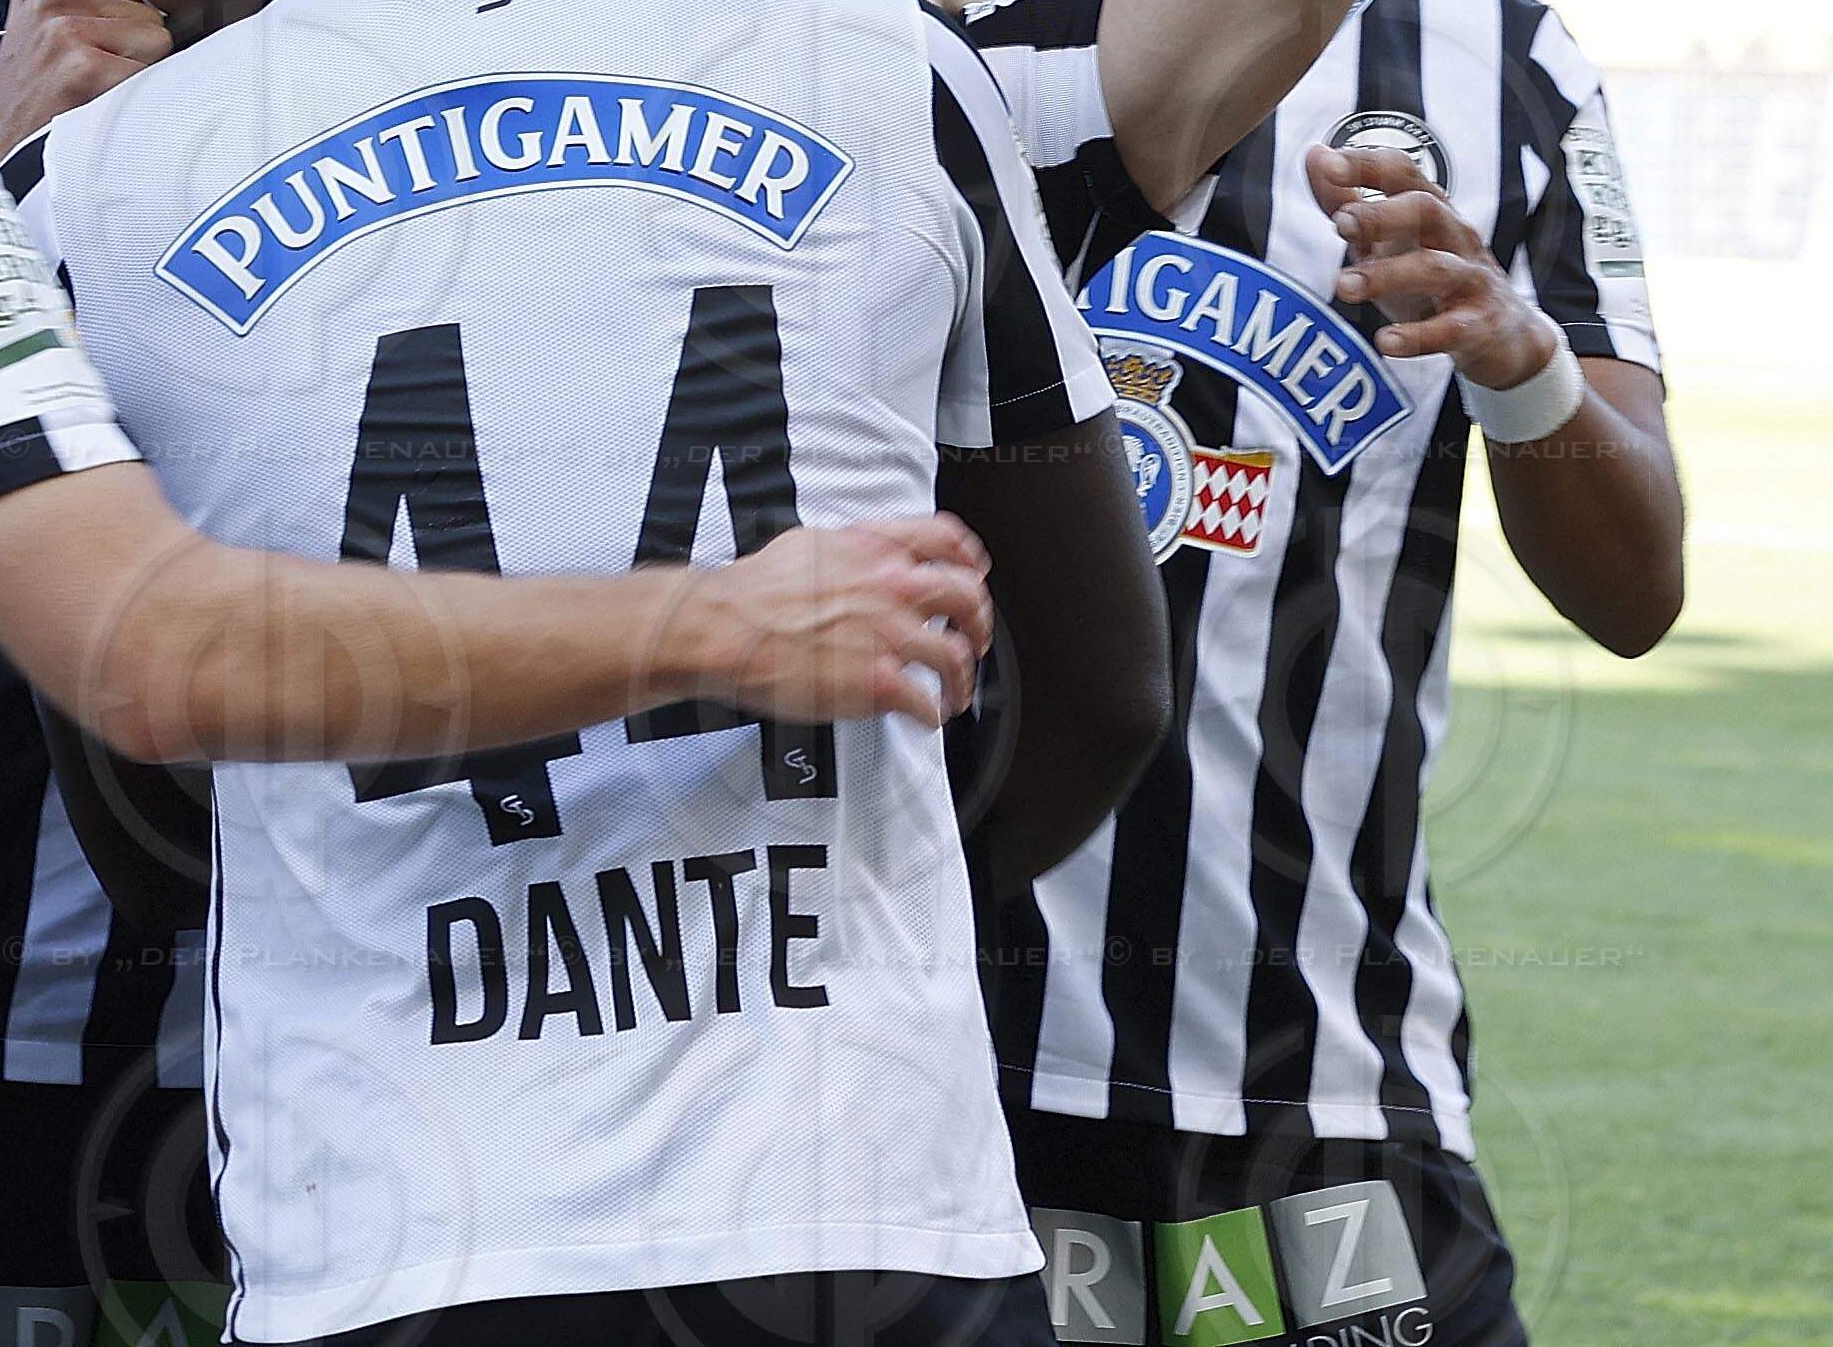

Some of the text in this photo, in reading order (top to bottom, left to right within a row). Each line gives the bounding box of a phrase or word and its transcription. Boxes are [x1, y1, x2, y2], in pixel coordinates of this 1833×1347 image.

[192, 96, 811, 301] PUNTIGAMER
[1077, 245, 1377, 447] IGAMER
[342, 284, 837, 847] 44
[425, 844, 830, 1046] DANTE
[1051, 1198, 1393, 1337] RAZ
